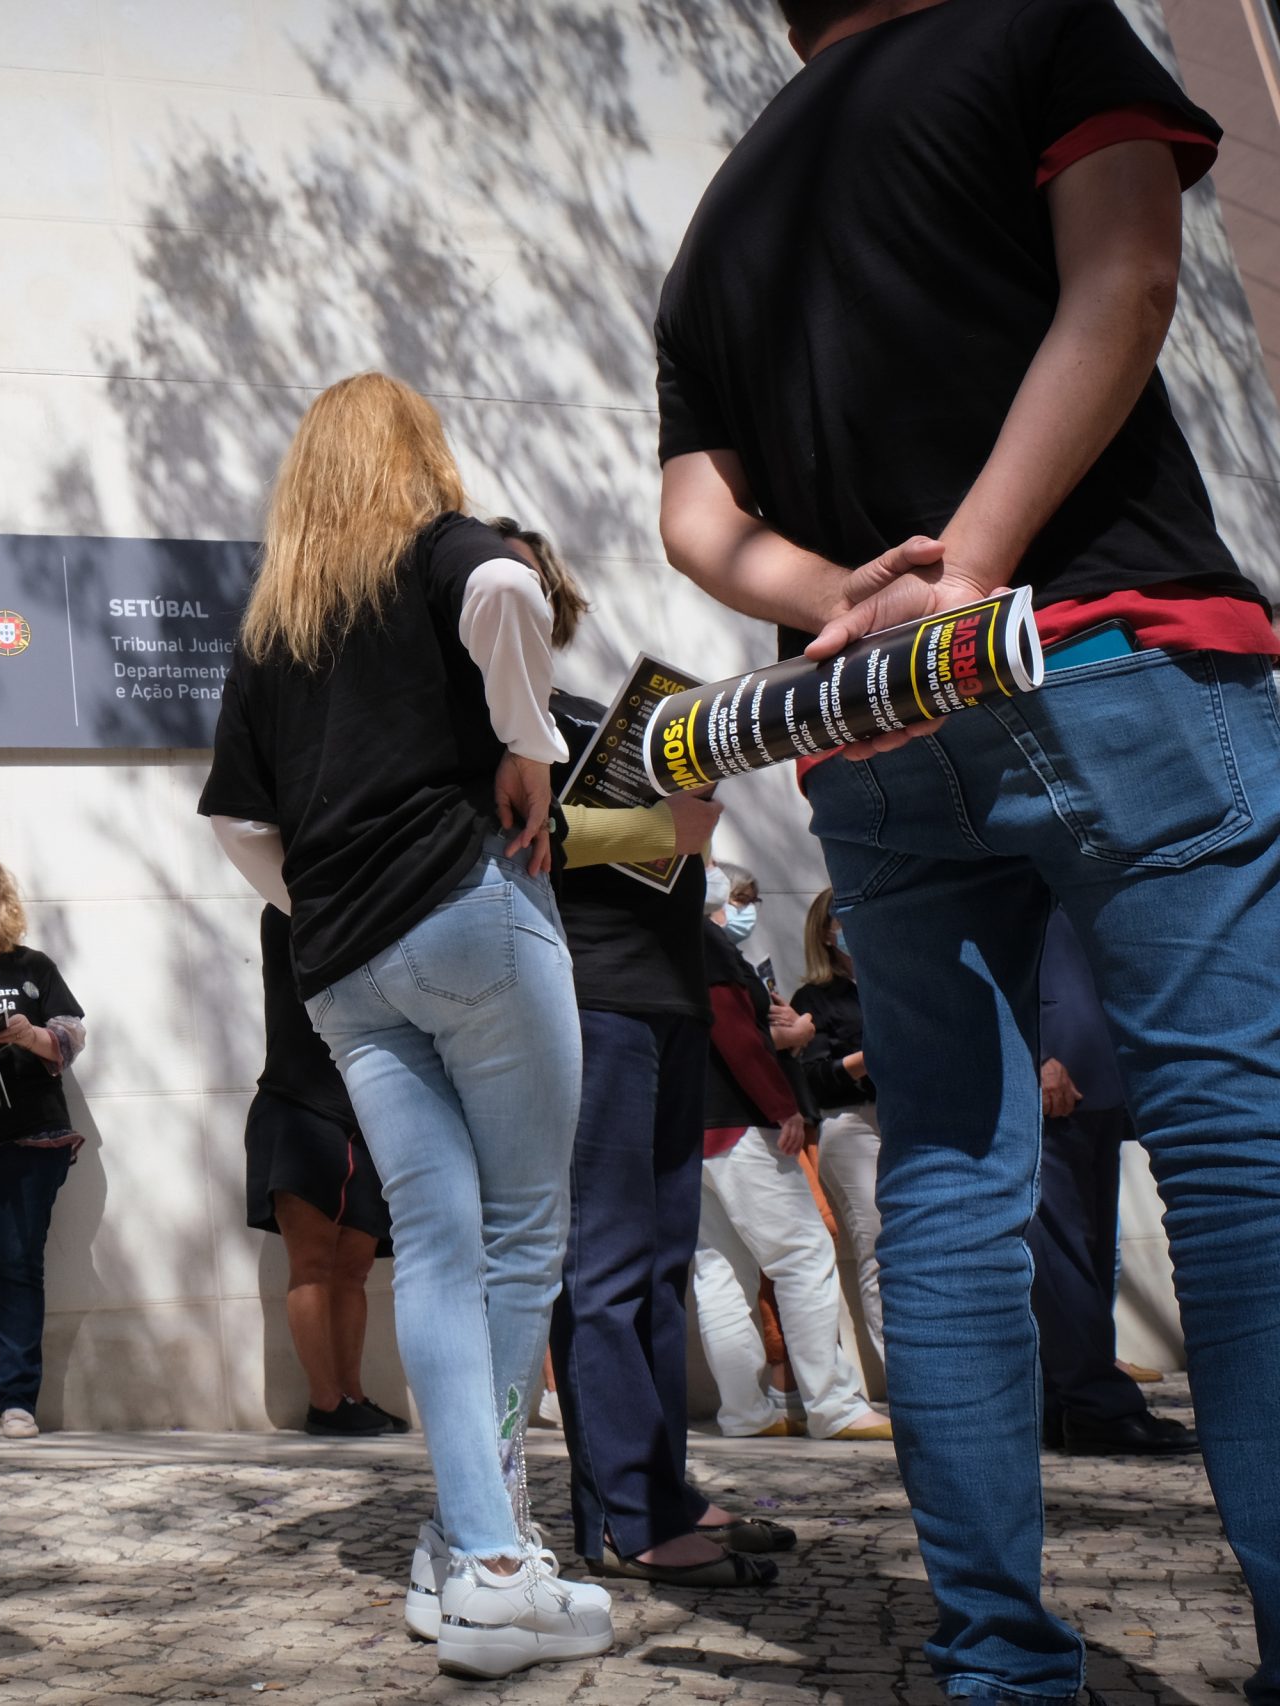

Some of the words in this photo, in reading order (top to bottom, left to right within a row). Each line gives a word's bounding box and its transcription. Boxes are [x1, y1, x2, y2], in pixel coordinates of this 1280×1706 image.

[109, 595, 209, 618] SETÚBAL
[111, 636, 183, 652] Tribunal
[928, 625, 943, 649] PASSA
[939, 621, 956, 649] HORA
[927, 650, 936, 669] QUE
[938, 650, 951, 681] UMA
[953, 615, 981, 694] GREVE
[867, 648, 880, 694] SITUAÇÕES
[929, 671, 939, 690] DIA
[116, 686, 126, 698] e
[131, 683, 173, 701] Ação
[831, 657, 845, 717] RECUPERAÇÃO
[944, 683, 961, 705] MAIS
[785, 688, 796, 732] INTEGRAL
[820, 682, 838, 739] VENCIMENTO
[869, 696, 881, 716] DAS
[935, 692, 951, 712] CADA
[729, 721, 737, 734] DE
[836, 720, 848, 731] DE
